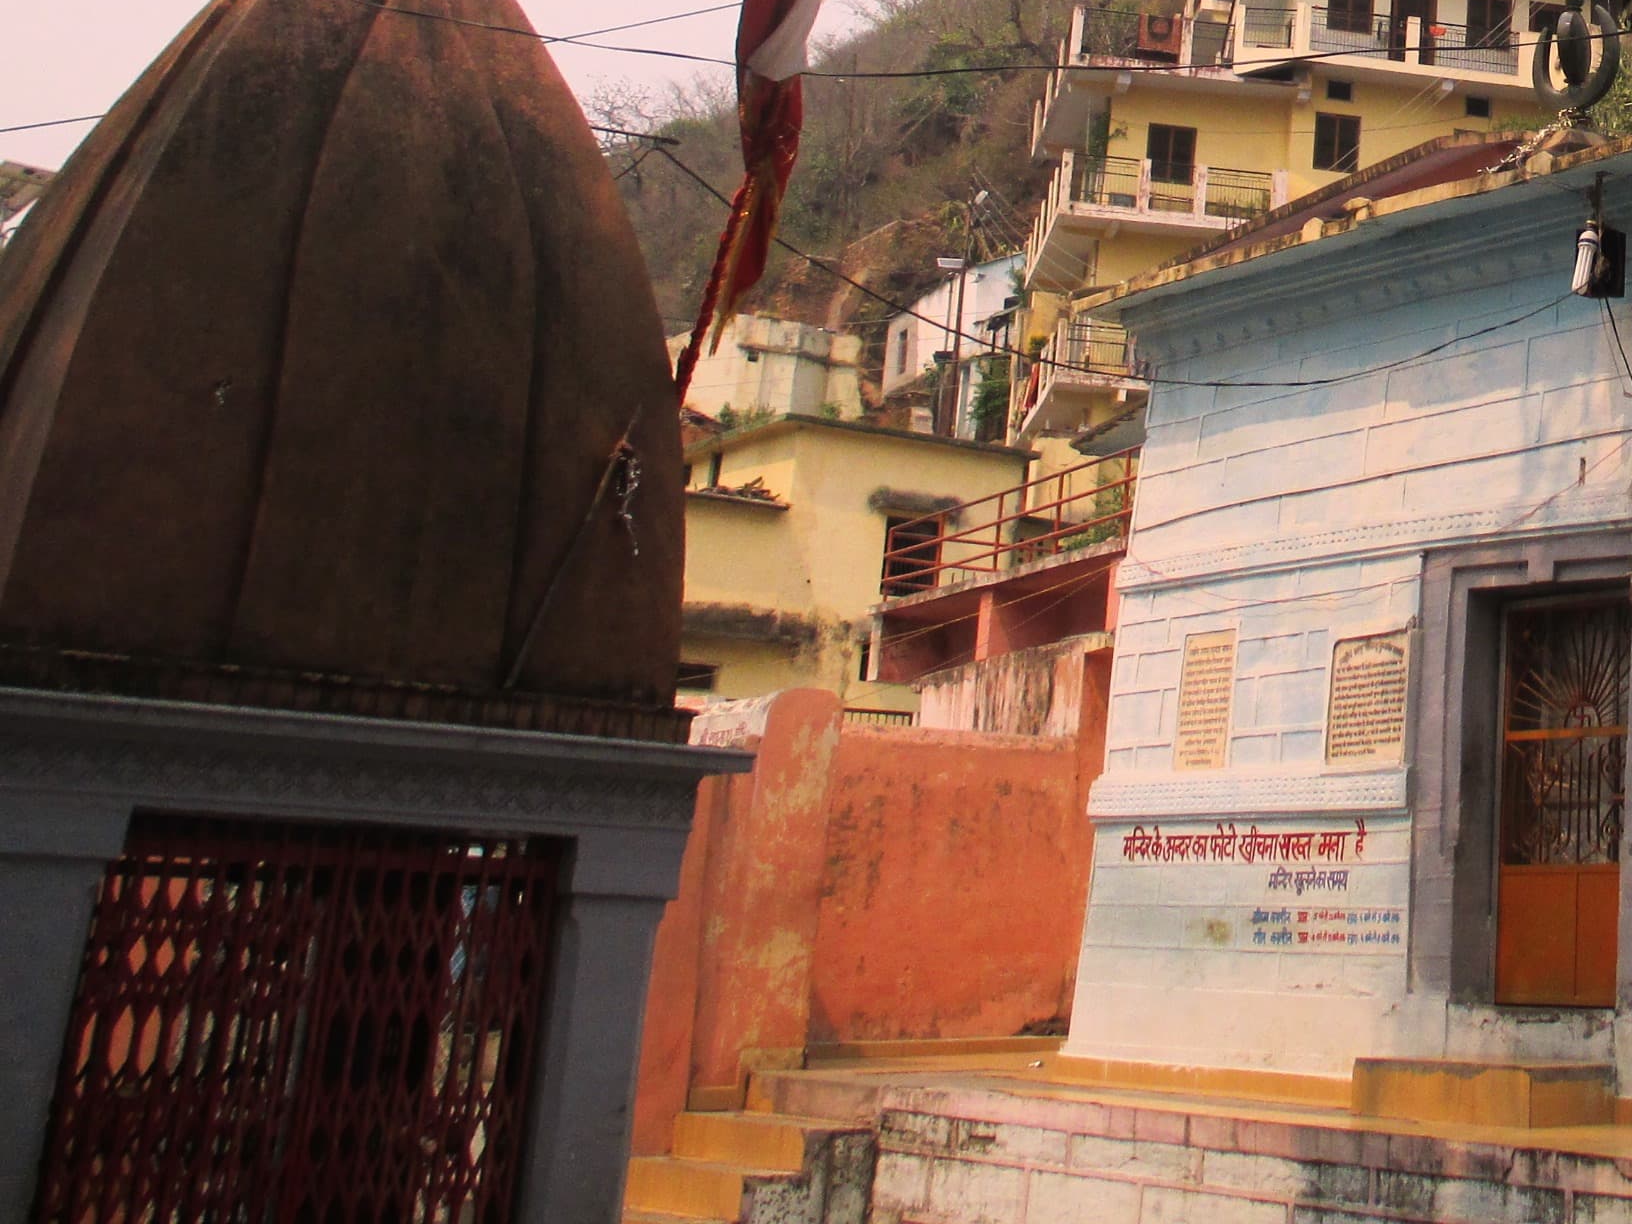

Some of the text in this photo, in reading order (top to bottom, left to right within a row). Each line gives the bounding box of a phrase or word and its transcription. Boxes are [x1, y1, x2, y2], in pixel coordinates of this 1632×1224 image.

[1123, 825, 1153, 861] मन्दिर
[1151, 824, 1162, 862] के
[1163, 834, 1194, 862] अन्दर
[1193, 834, 1210, 862] का
[1210, 823, 1238, 861] फोटो
[1279, 832, 1315, 862] सख्त
[1318, 831, 1352, 862] मना
[1355, 817, 1367, 861] है
[1315, 871, 1327, 889] का
[1327, 870, 1350, 891] समय
